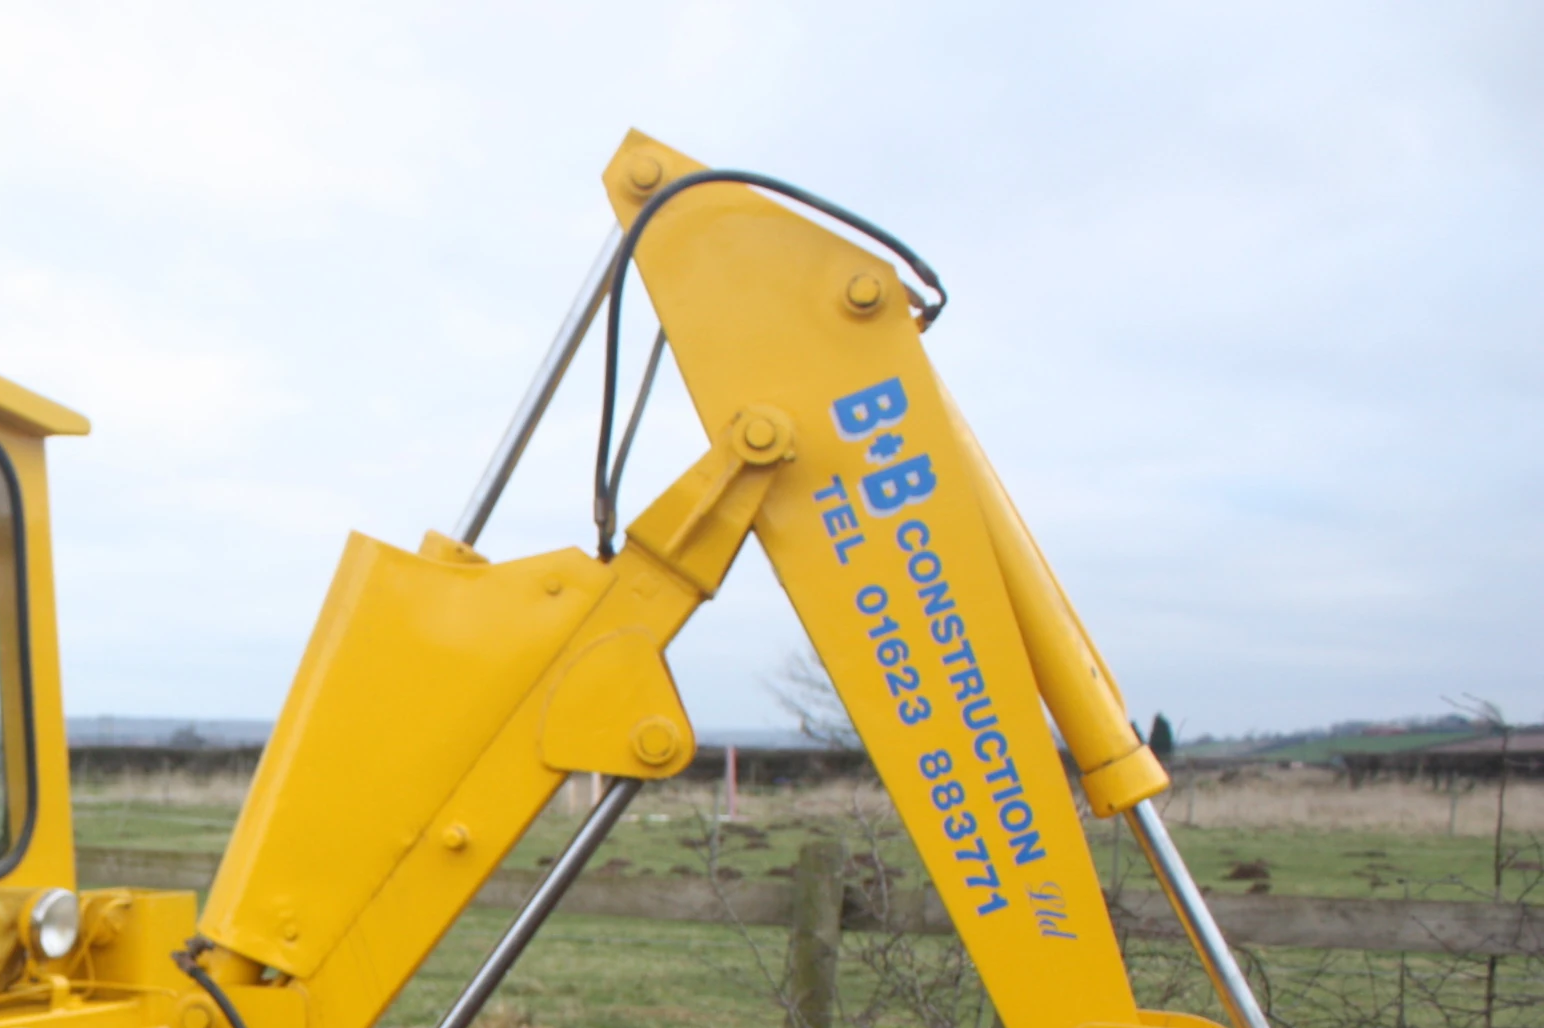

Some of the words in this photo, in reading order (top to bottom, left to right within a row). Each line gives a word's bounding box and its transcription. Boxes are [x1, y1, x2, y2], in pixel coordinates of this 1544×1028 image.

[813, 475, 866, 566] TEL
[855, 584, 933, 727] 01623
[919, 749, 1010, 917] 883771
[896, 519, 1048, 867] CONSTRUCTION
